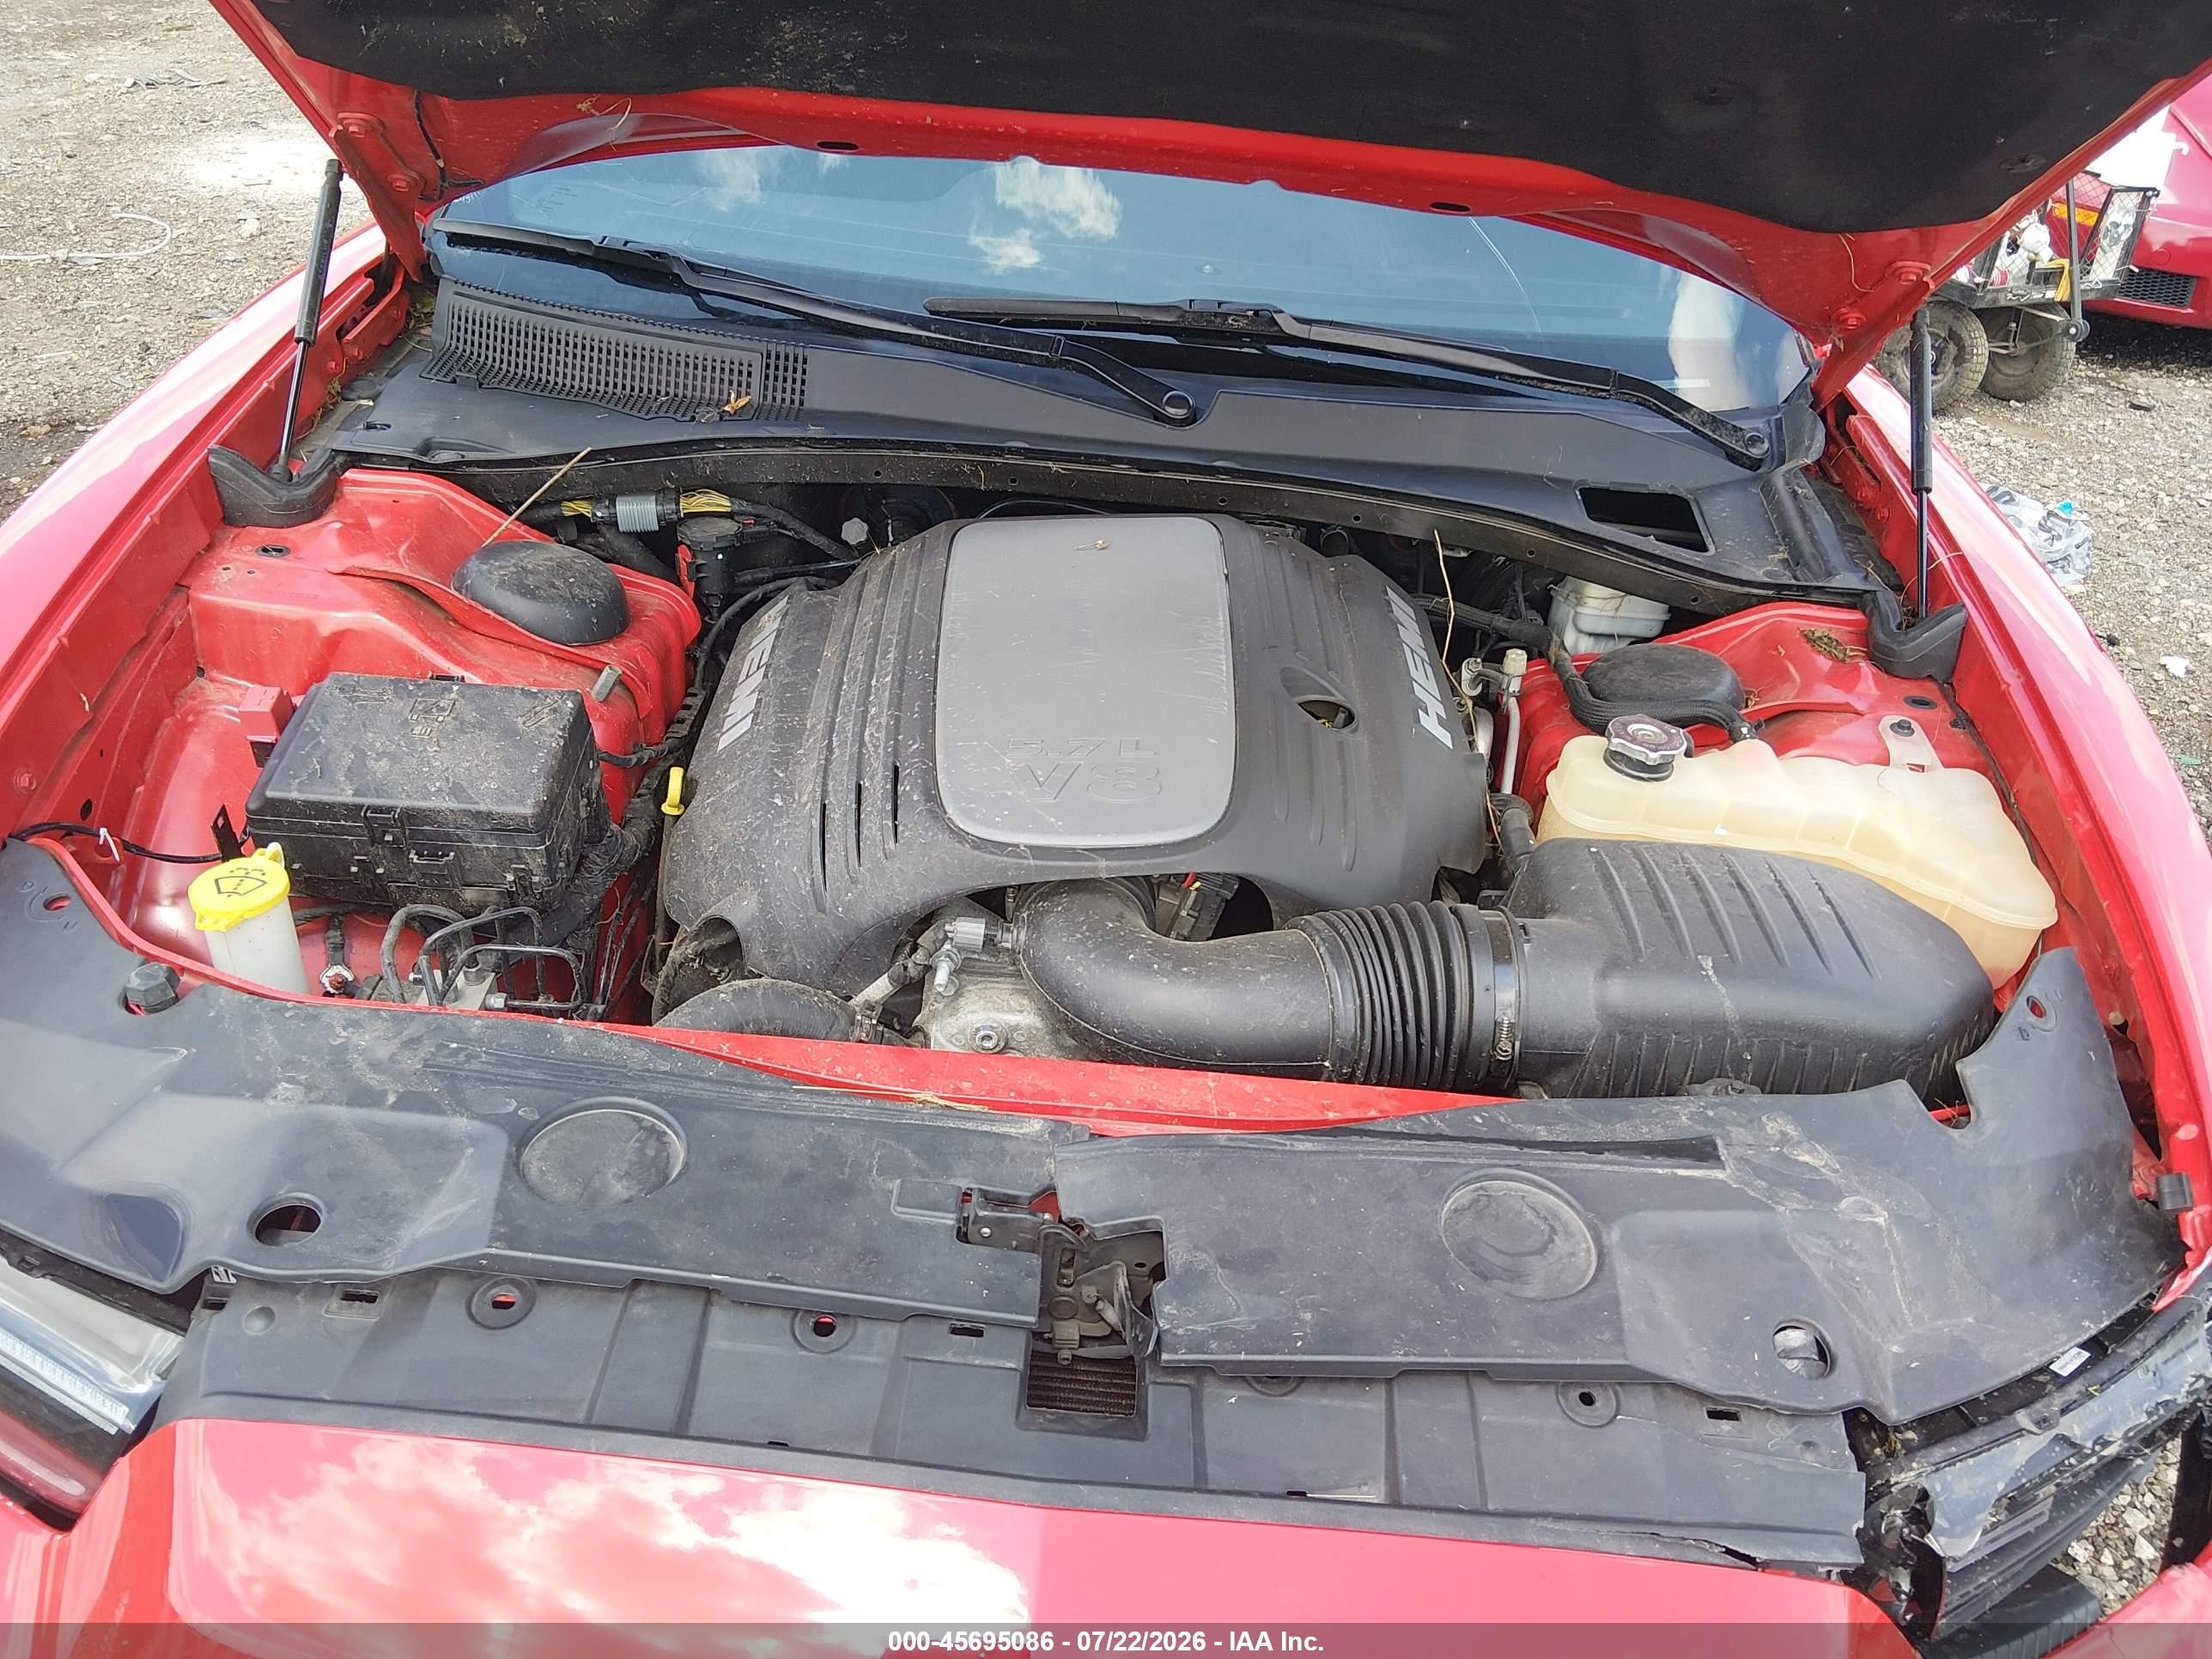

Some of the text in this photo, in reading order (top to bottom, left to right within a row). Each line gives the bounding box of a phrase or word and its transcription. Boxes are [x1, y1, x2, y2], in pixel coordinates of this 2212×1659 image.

[717, 593, 789, 753] HEMI
[1385, 584, 1453, 750] HEMI
[1006, 760, 1164, 804] V8
